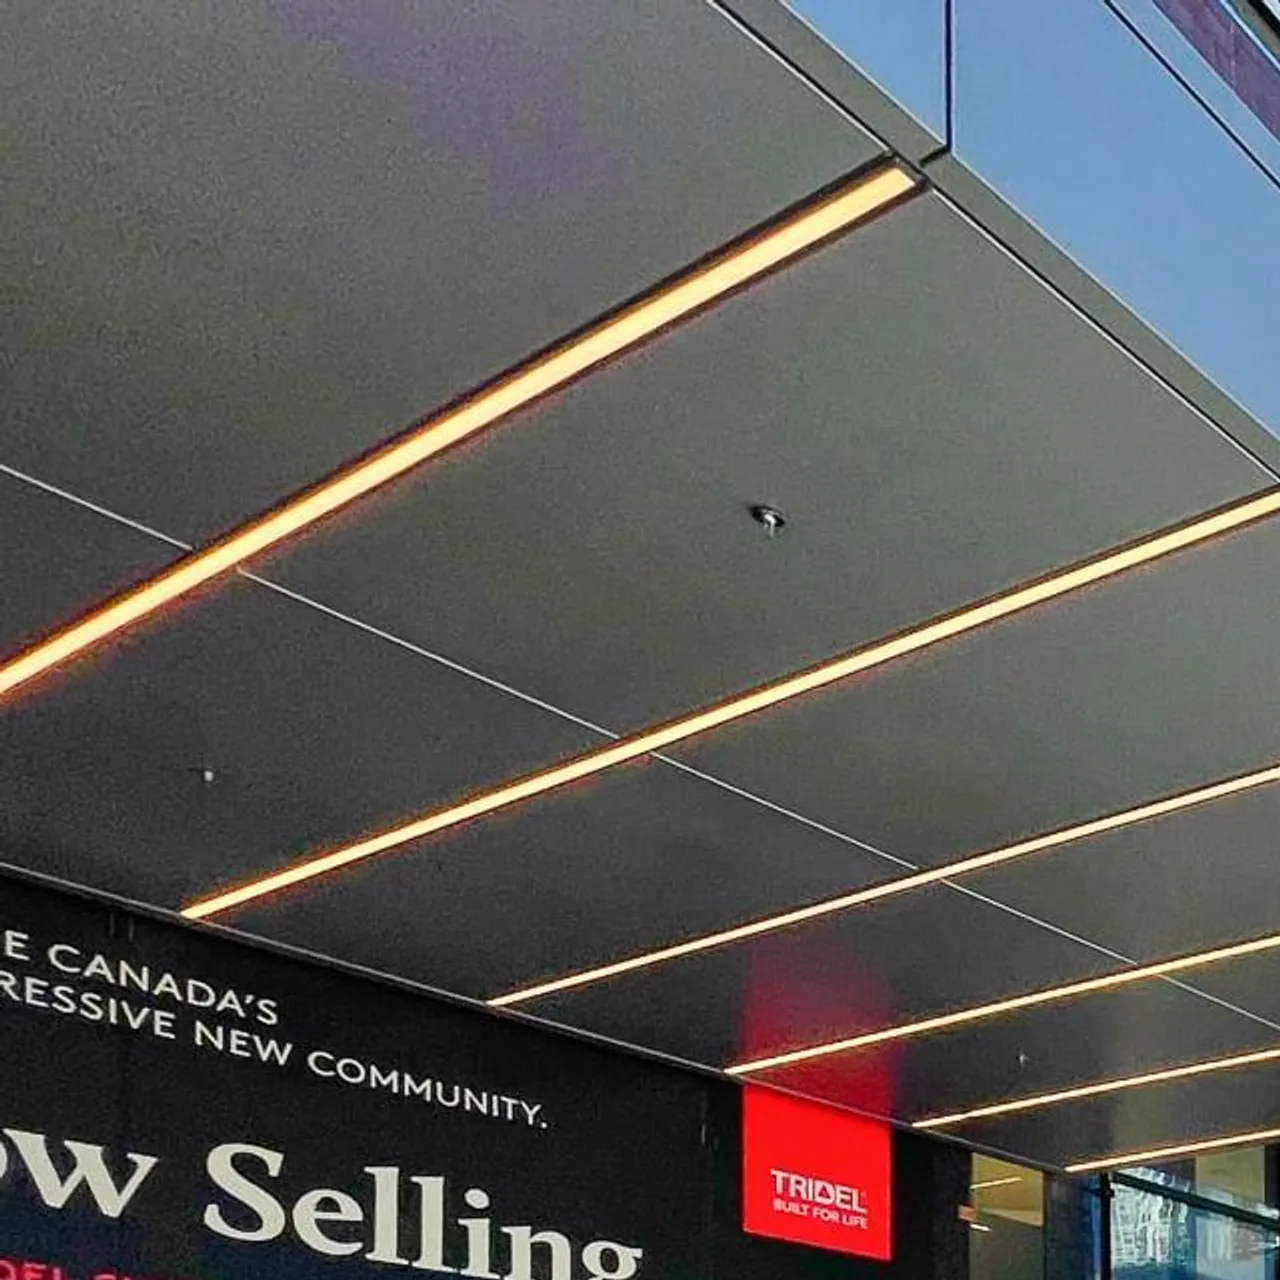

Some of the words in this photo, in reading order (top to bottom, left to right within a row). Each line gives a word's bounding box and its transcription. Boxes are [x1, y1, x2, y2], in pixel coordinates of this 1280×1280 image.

[48, 943, 278, 1026] CANADA'S
[194, 1020, 293, 1066] NEW
[307, 1051, 548, 1128] COMMUNITY.
[770, 1168, 869, 1215] TRIDEL
[773, 1197, 810, 1216] BUILT
[812, 1206, 840, 1224] FOR
[842, 1213, 869, 1230] LIFE
